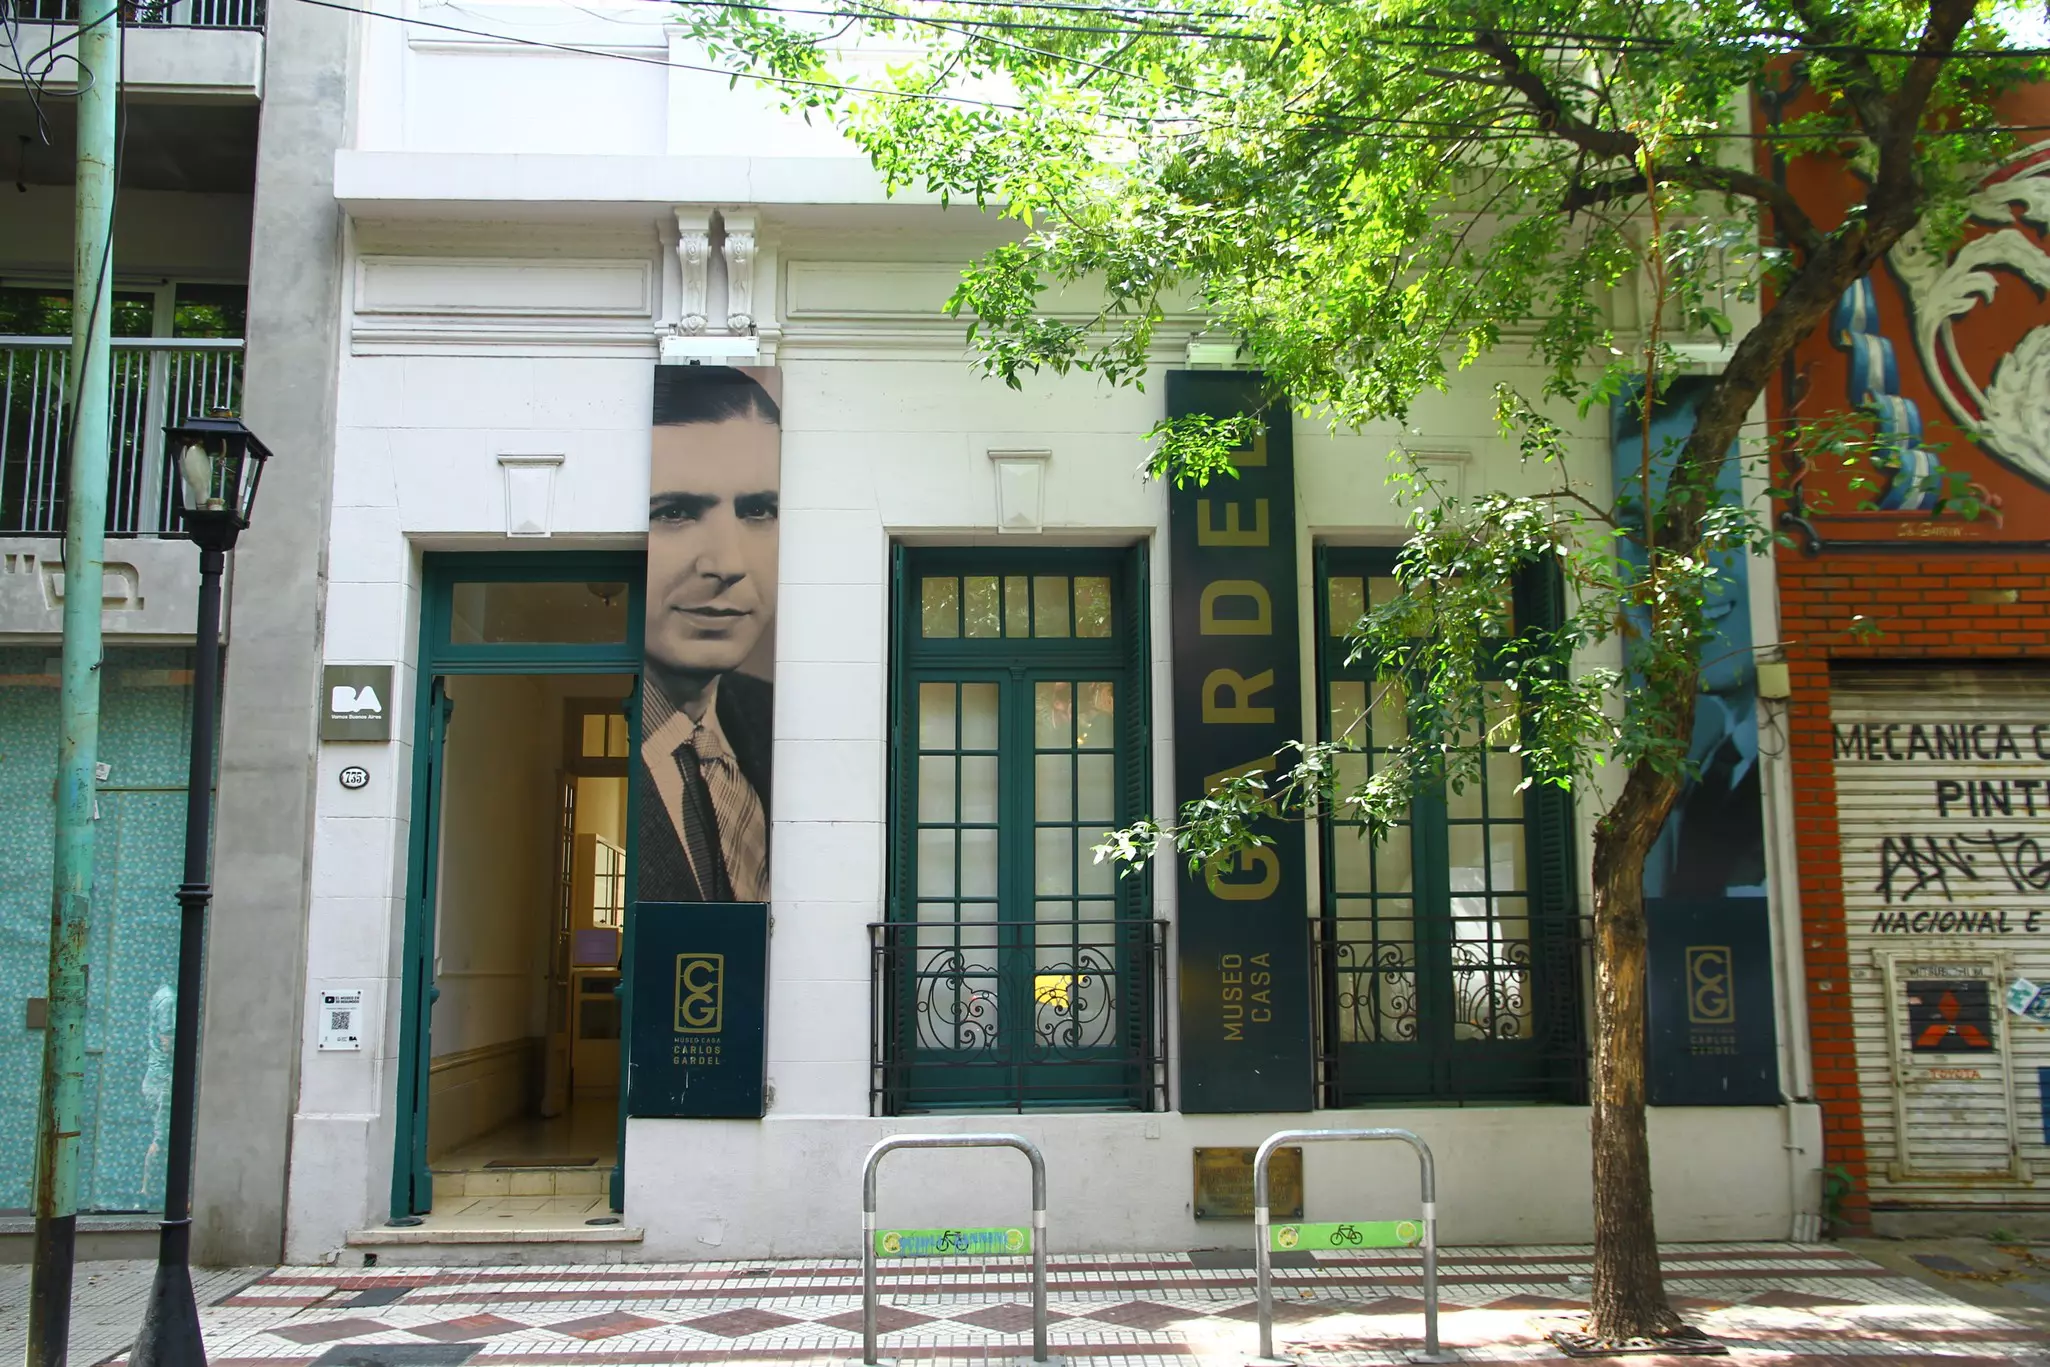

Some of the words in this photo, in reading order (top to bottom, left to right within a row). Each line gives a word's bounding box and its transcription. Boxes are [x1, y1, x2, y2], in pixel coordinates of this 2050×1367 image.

[331, 685, 382, 713] BA
[1832, 724, 2021, 760] MECANICA
[346, 771, 362, 784] 735
[1936, 780, 2050, 817] PINT
[1871, 912, 2013, 933] NACIONAL
[2025, 912, 2043, 932] E
[1222, 954, 1244, 1041] MUSEO
[1250, 952, 1272, 1023] CASA
[673, 1045, 721, 1054] CARLOS
[673, 1056, 721, 1065] GARDEL
